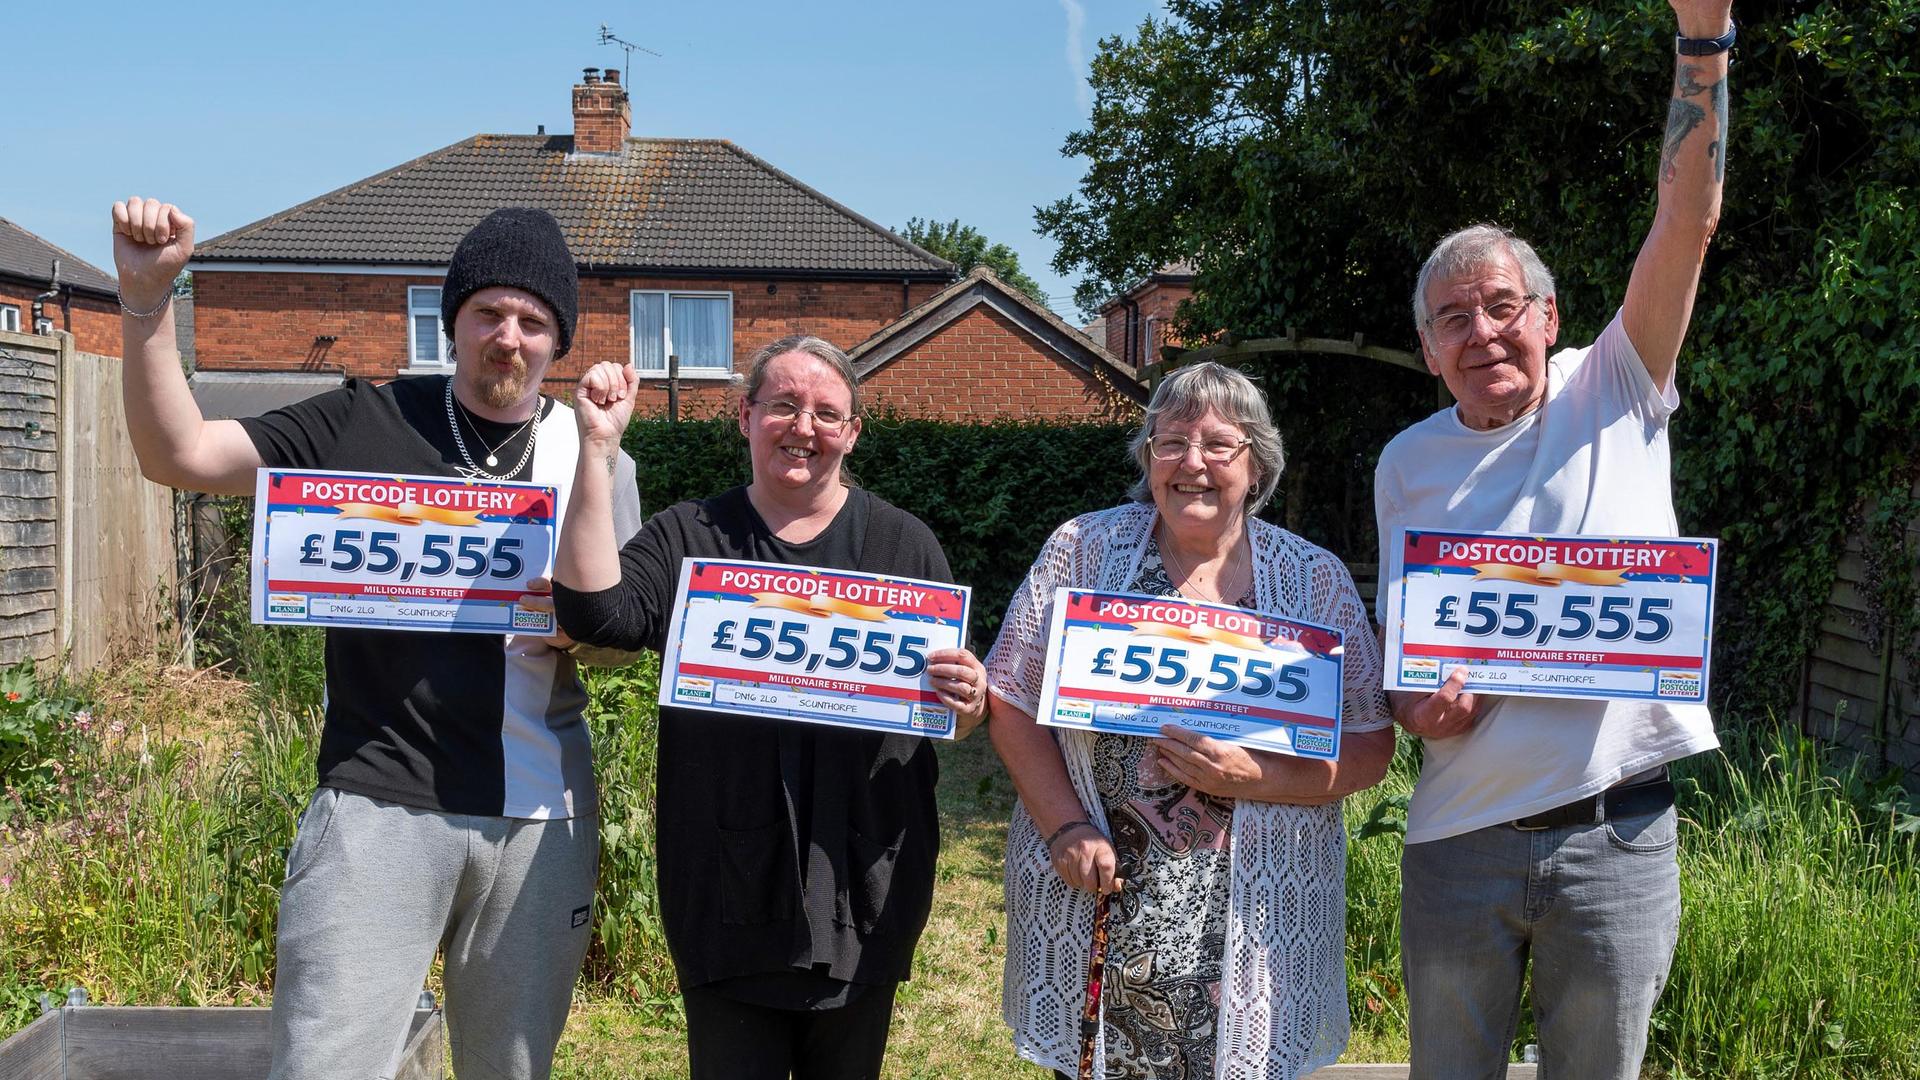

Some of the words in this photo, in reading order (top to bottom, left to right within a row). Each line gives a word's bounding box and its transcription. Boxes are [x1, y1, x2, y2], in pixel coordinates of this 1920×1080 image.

[302, 481, 417, 504] POSTCODE
[424, 488, 518, 509] LOTTERY
[300, 529, 524, 582] £55,555
[1438, 541, 1557, 565] POSTCODE
[1564, 547, 1667, 567] LOTTERY
[364, 585, 427, 596] MILLIONAIRE
[429, 588, 465, 598] STREET
[720, 570, 830, 597] POSTCODE
[835, 581, 926, 608] LOTTERY
[274, 605, 301, 613] PLANET
[330, 604, 353, 613] DN16
[357, 606, 375, 615] 2LQ
[398, 608, 457, 618] SCUNTHORPE
[515, 616, 549, 624] POSTCODE
[1099, 601, 1208, 629] POSTCODE
[1214, 612, 1303, 642] LOTTERY
[1434, 591, 1673, 647] £55,555
[711, 617, 928, 678] £55,555
[1496, 650, 1564, 661] MILLIONAIRE
[1566, 652, 1605, 662] STREET
[1091, 644, 1310, 703] £55,555
[1407, 671, 1433, 679] PLANET
[1467, 671, 1485, 679] N16
[1488, 671, 1507, 680] 2LQ
[1531, 673, 1596, 684] SCUNTHORPE
[768, 674, 830, 688] MILLIONAIRE
[832, 681, 867, 693] STREET
[1660, 683, 1699, 691] POSTCODE
[681, 688, 707, 698] PLANET
[734, 692, 756, 701] DN16
[760, 695, 778, 703] 2LQ
[799, 699, 858, 713] SCUNTHORPE
[1149, 696, 1211, 709] MILLIONAIRE
[1213, 702, 1249, 714] STREET
[913, 716, 947, 725] POSTCODE
[1062, 709, 1087, 718] PLANET
[1115, 713, 1138, 721] DN16
[1141, 716, 1159, 724] 2LQ
[1181, 719, 1240, 732] SCUNTHORPE
[1297, 738, 1332, 748] POSTCODE
